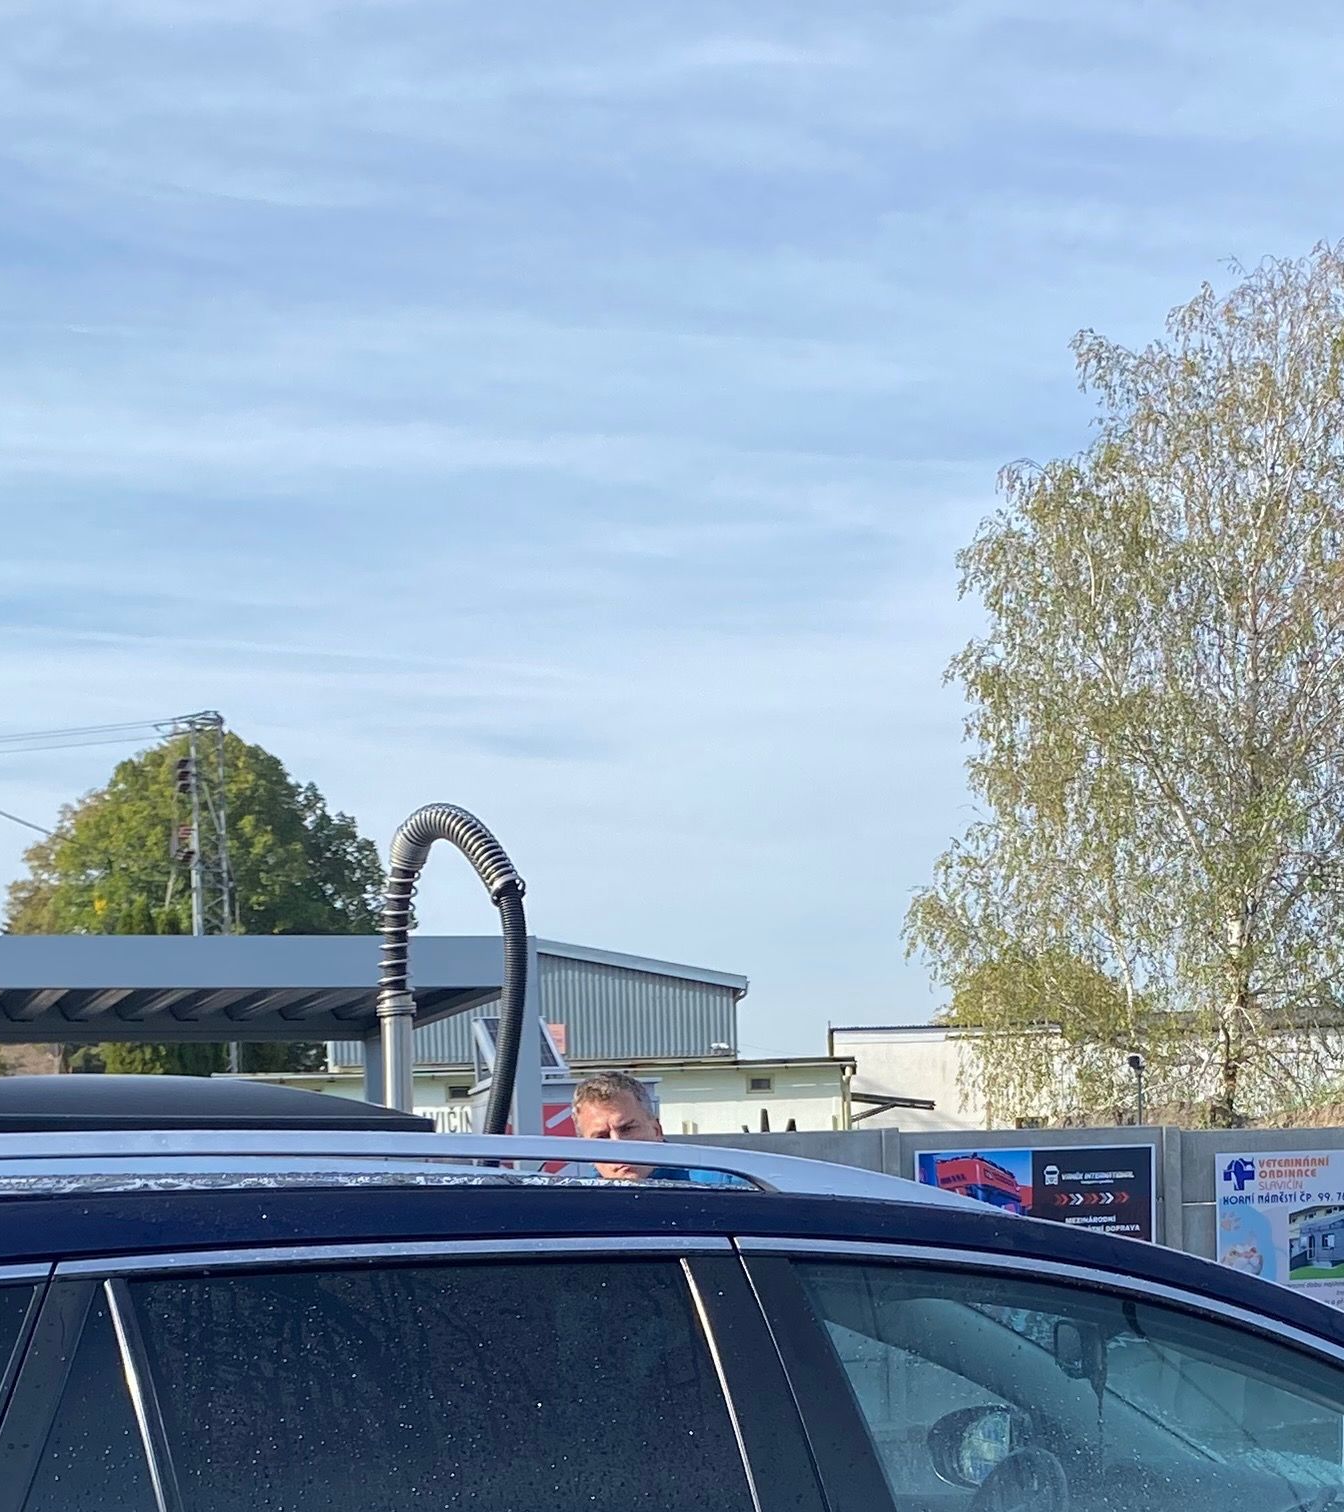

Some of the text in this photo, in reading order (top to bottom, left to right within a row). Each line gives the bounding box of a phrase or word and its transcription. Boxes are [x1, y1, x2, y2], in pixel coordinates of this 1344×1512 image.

[1259, 1156, 1329, 1168] VETERINÁRNÍ
[1259, 1169, 1316, 1179] ORDINACE
[1259, 1180, 1303, 1190] SLAVIČÍN
[1223, 1193, 1254, 1205] HORNÍ
[1258, 1190, 1297, 1204] NÁMĚSTÍ
[1105, 1224, 1140, 1232] DOPRAVA
